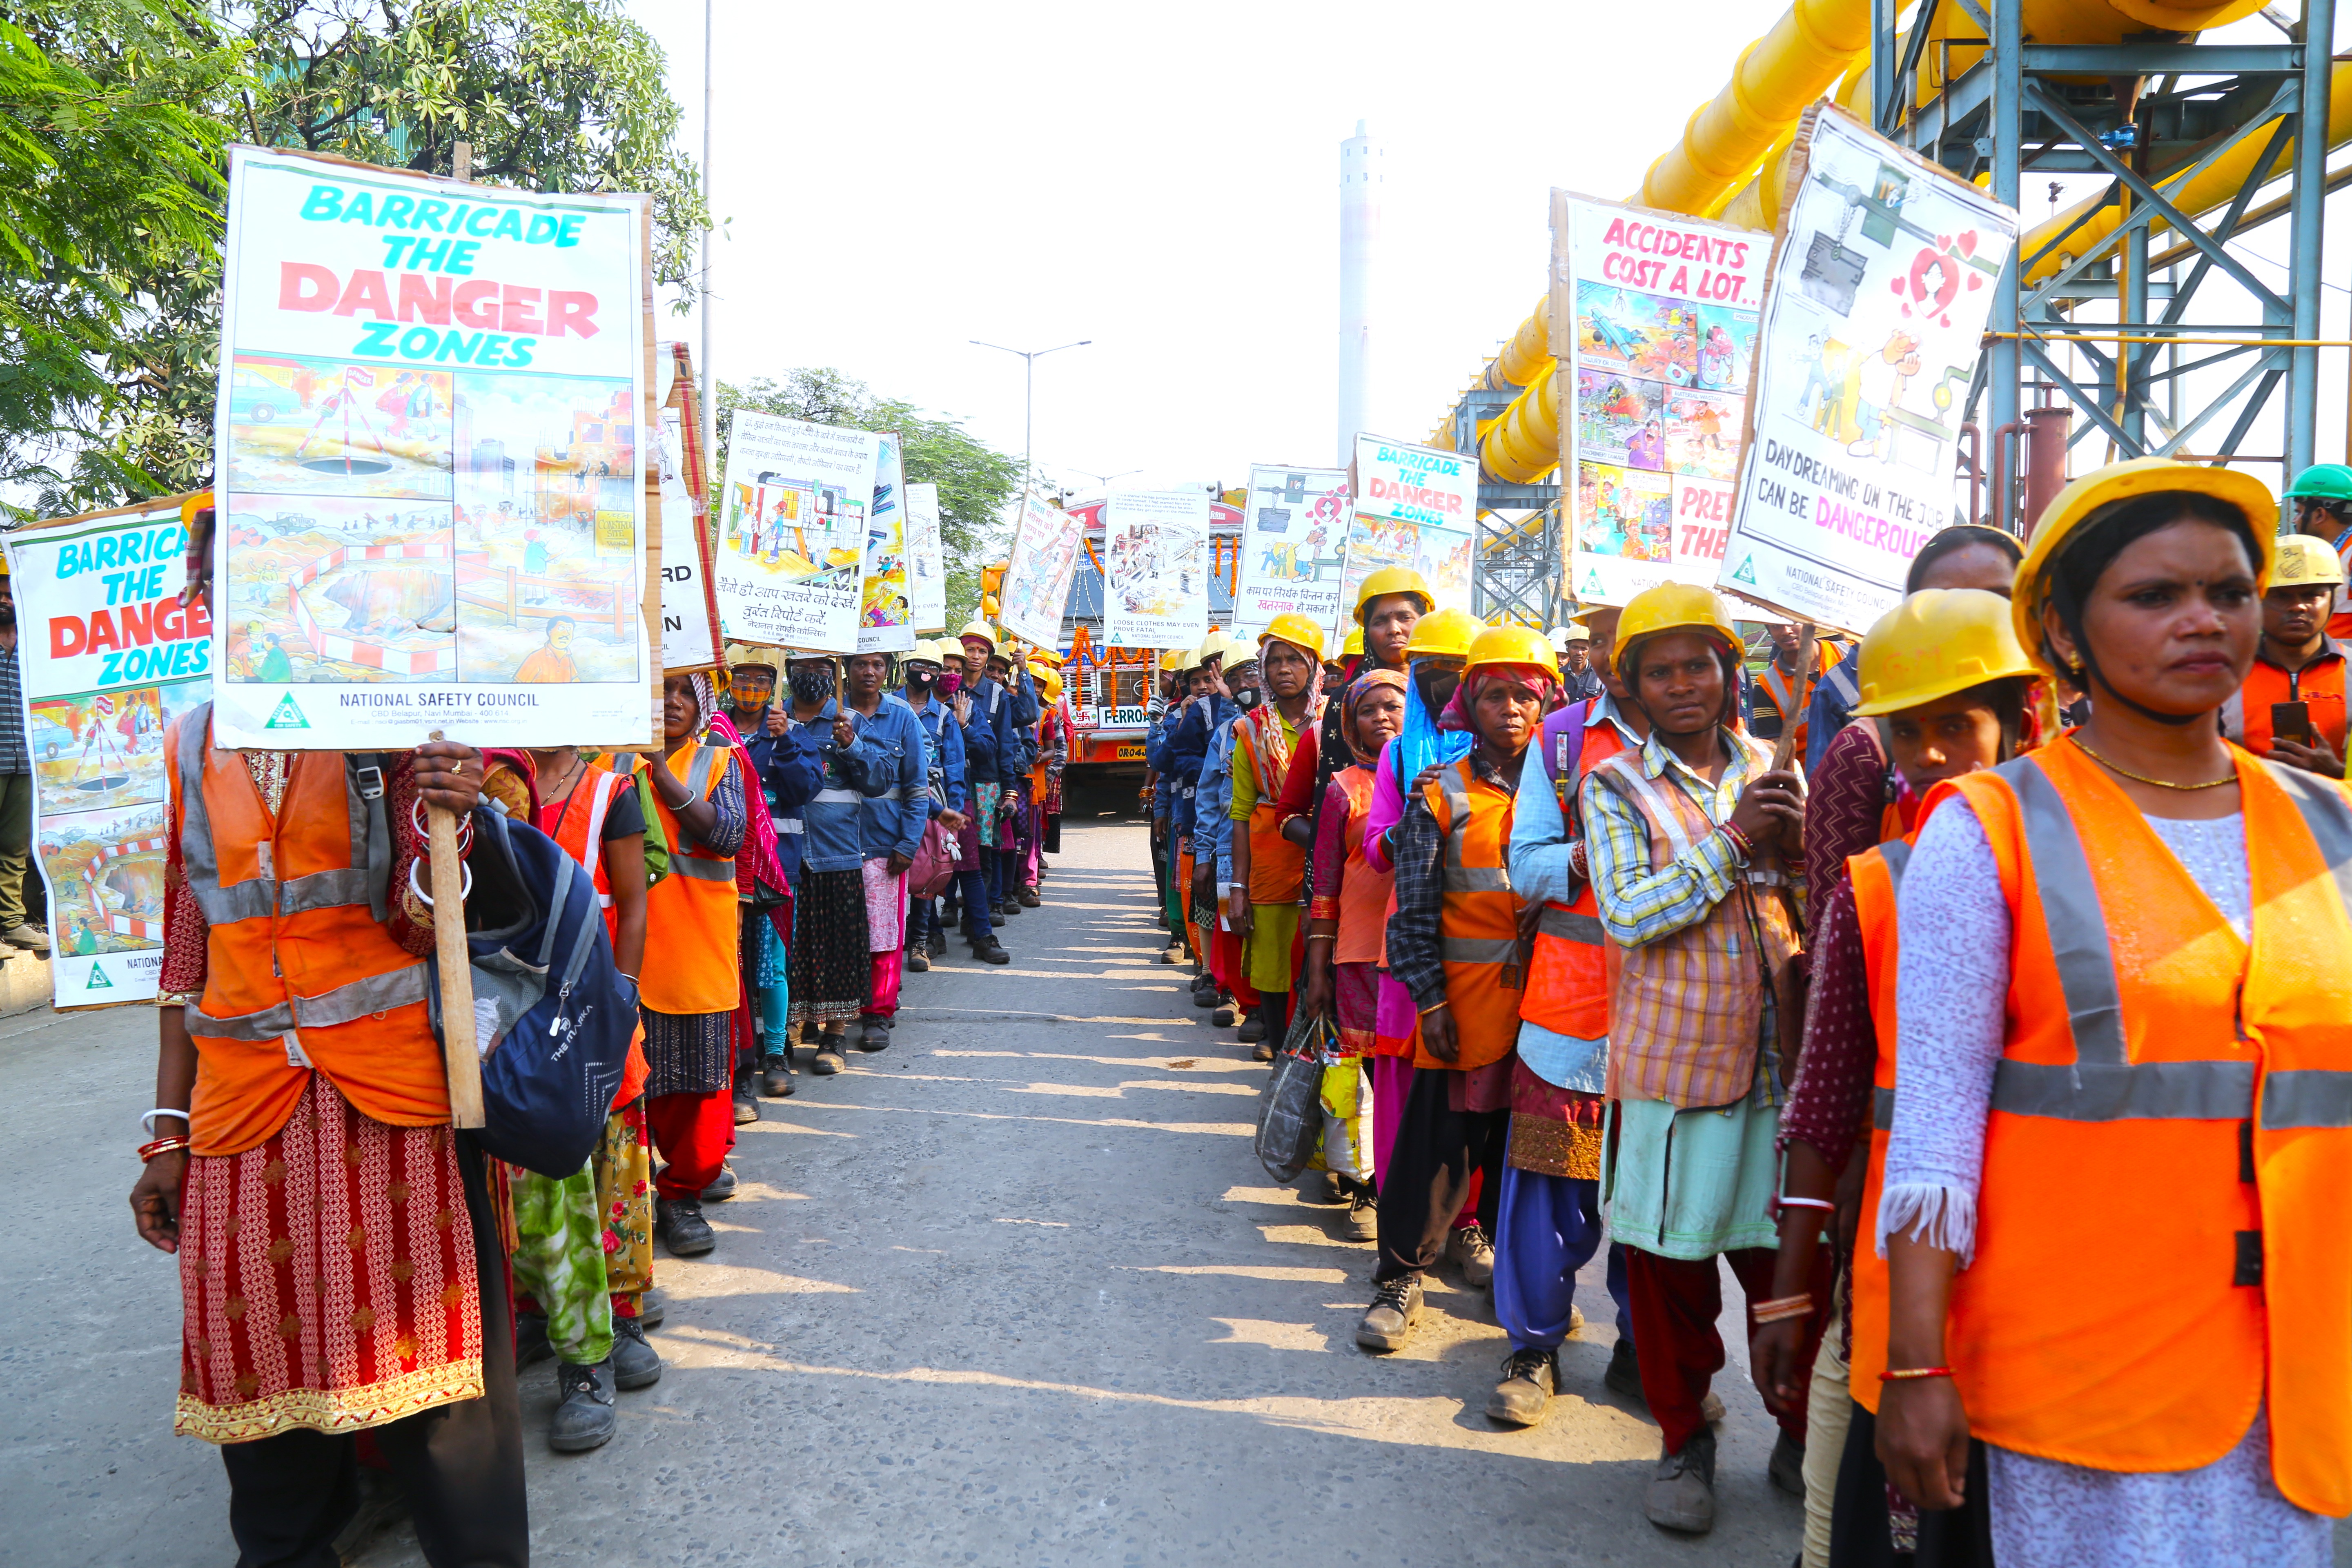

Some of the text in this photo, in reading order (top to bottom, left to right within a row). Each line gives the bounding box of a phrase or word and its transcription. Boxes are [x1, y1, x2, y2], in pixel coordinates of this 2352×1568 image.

[299, 185, 586, 247] BARRICADE
[382, 235, 481, 275] THE
[1603, 218, 1749, 269] ACCIDENTS
[1603, 252, 1667, 289] COST
[1669, 265, 1688, 295] A
[278, 261, 600, 340] DANGER
[352, 322, 537, 367] ZONES
[348, 369, 372, 384] DANGER
[1675, 391, 1699, 399] MATERIAL
[1377, 446, 1461, 476] BARRICADE
[1399, 468, 1427, 487] THE
[1369, 477, 1462, 515] DANGER
[1758, 478, 1786, 509] CAN
[1789, 491, 1809, 519] BE
[1863, 483, 1880, 509] ON
[1888, 491, 1914, 521] THE
[1918, 503, 1943, 530] JOB
[1046, 510, 1054, 520] पर
[1390, 502, 1444, 525] ZONES
[1038, 530, 1045, 540] पर
[56, 526, 188, 579] BARRICA
[102, 565, 166, 605] THE
[739, 581, 753, 596] ही
[755, 587, 780, 599] आप
[781, 588, 812, 602] खतरे
[814, 590, 829, 605] को
[1247, 586, 1261, 596] काम
[1263, 588, 1272, 597] पर
[1786, 566, 1823, 589] NATIONAL
[1825, 580, 1854, 599] SAFETY
[1258, 600, 1336, 614] खतरनाक हो सकता है
[49, 593, 213, 659] DANGE
[748, 619, 773, 630] नेशनल
[98, 640, 209, 685] ZONES
[341, 693, 539, 706] NATIONAL SAFETY COUNCIL
[127, 956, 163, 969] NATIONA
[551, 1042, 568, 1061] THE
